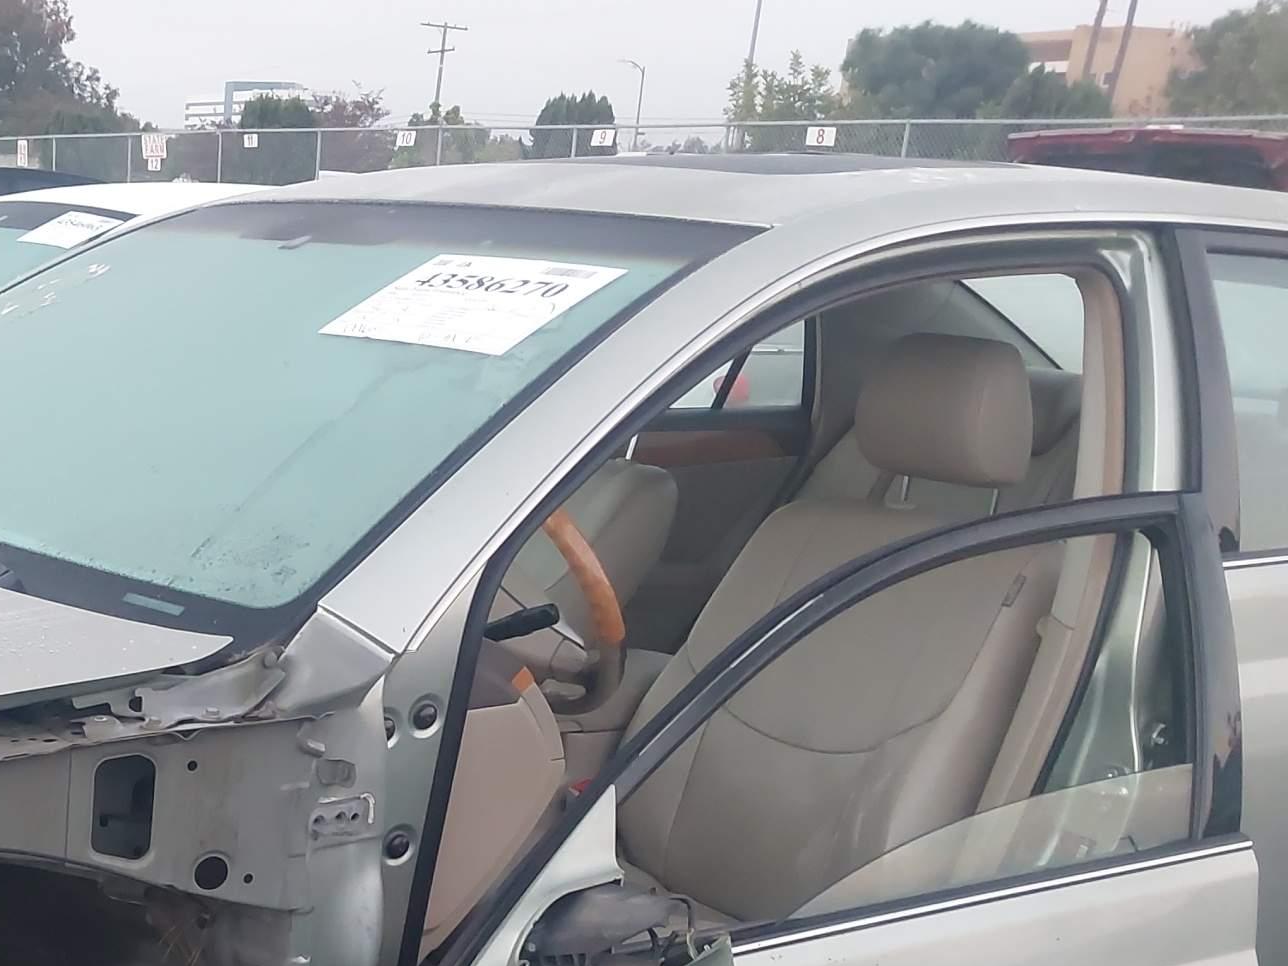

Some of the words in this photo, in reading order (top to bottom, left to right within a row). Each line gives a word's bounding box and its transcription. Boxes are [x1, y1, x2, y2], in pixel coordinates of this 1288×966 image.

[401, 131, 413, 145] 10
[598, 130, 607, 145] 9
[816, 128, 825, 145] 8
[150, 158, 160, 170] 12
[416, 272, 570, 298] 43586270
